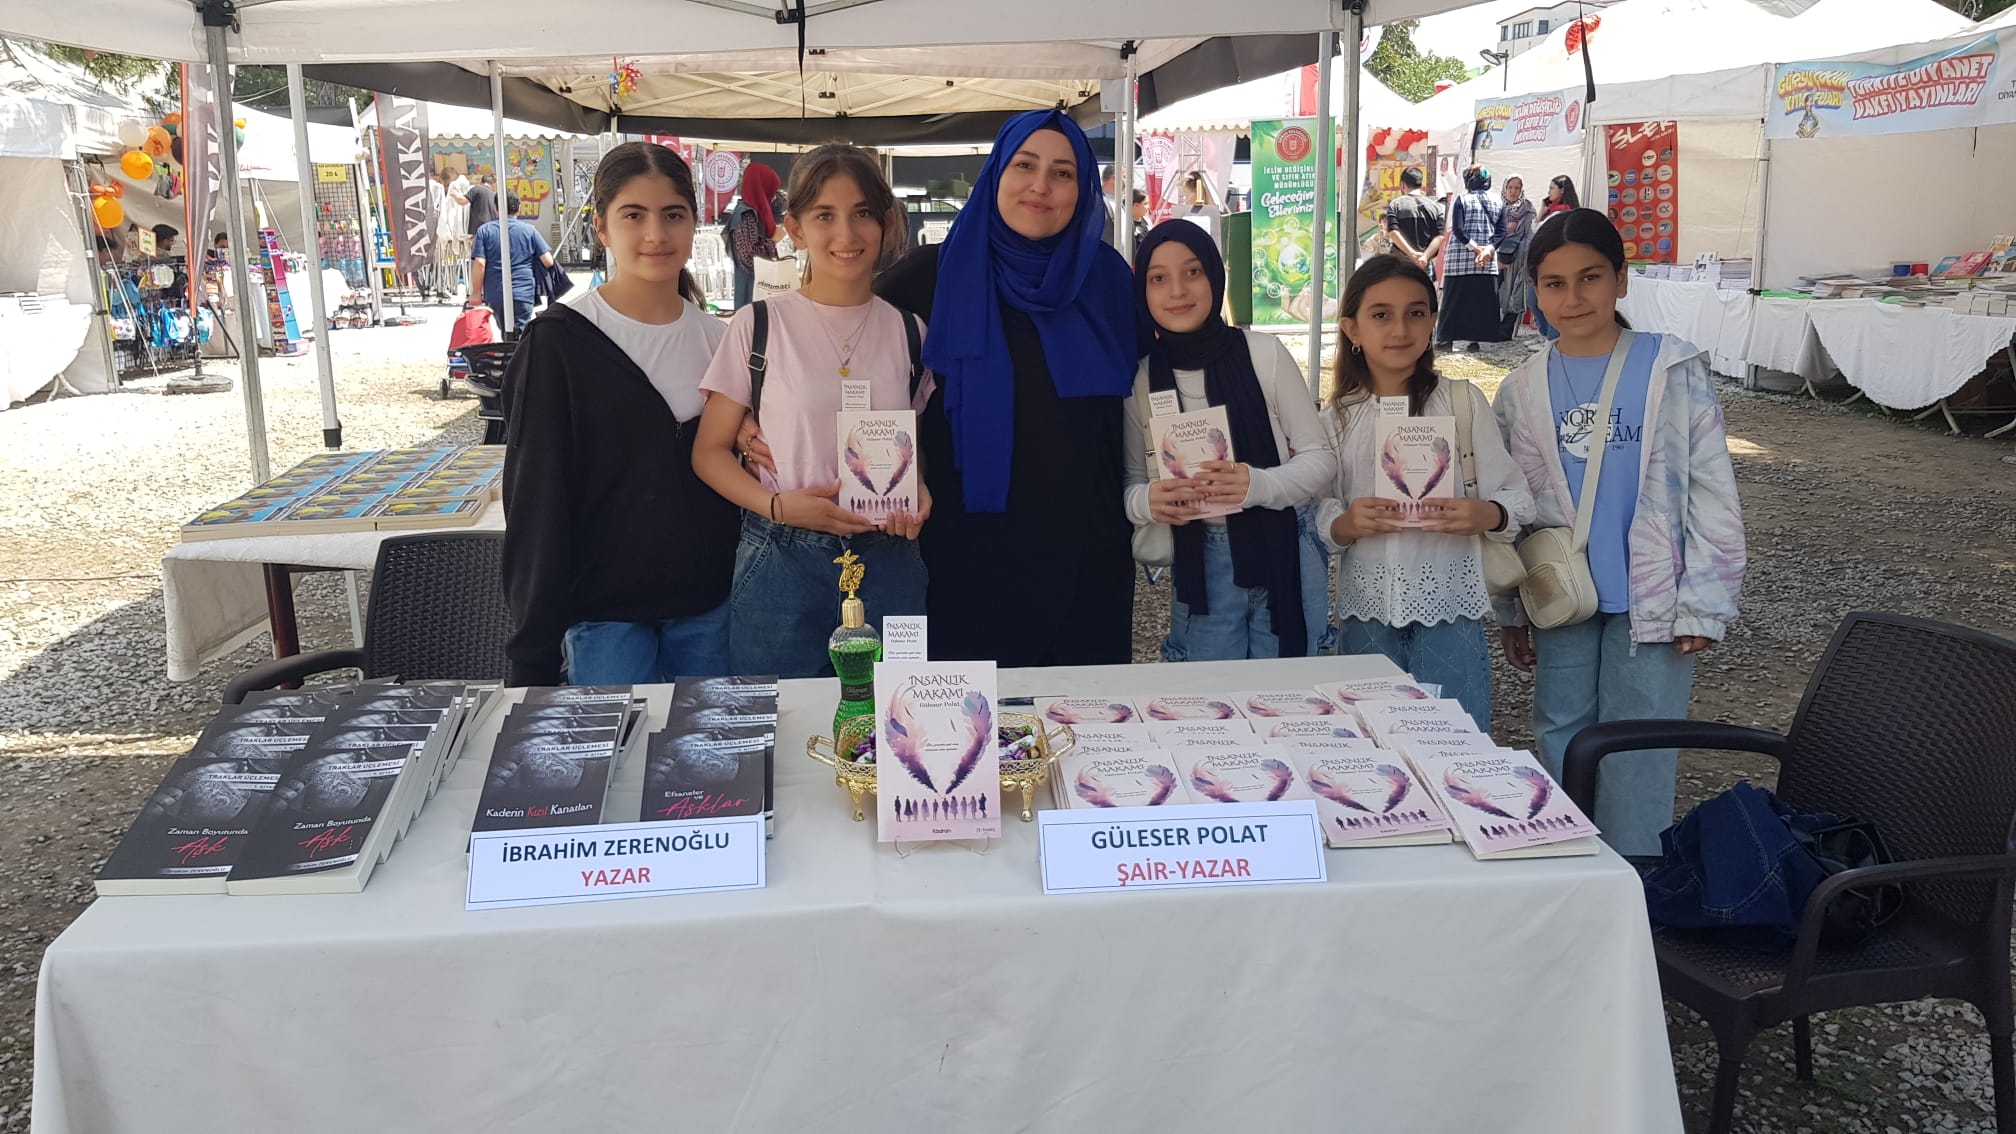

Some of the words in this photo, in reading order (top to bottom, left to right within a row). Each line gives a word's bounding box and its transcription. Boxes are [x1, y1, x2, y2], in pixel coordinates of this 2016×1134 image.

[1284, 164, 1314, 173] DEĞİŞİKL
[1560, 408, 1623, 427] NORH
[912, 688, 964, 700] MAKAMI
[486, 807, 524, 817] Kaderin
[550, 803, 593, 815] Kanatları
[294, 821, 325, 830] Zaman
[326, 816, 372, 828] Boyutunda
[201, 828, 248, 836] Boyutunda
[1091, 826, 1191, 849] GÜLESER
[1197, 824, 1268, 845] POLAT
[502, 838, 597, 863] İBRAHİM
[604, 830, 730, 857] ZERENOĞLU
[581, 867, 651, 887] YAZAR
[1117, 858, 1251, 886] ŞAİR-YAZAR
